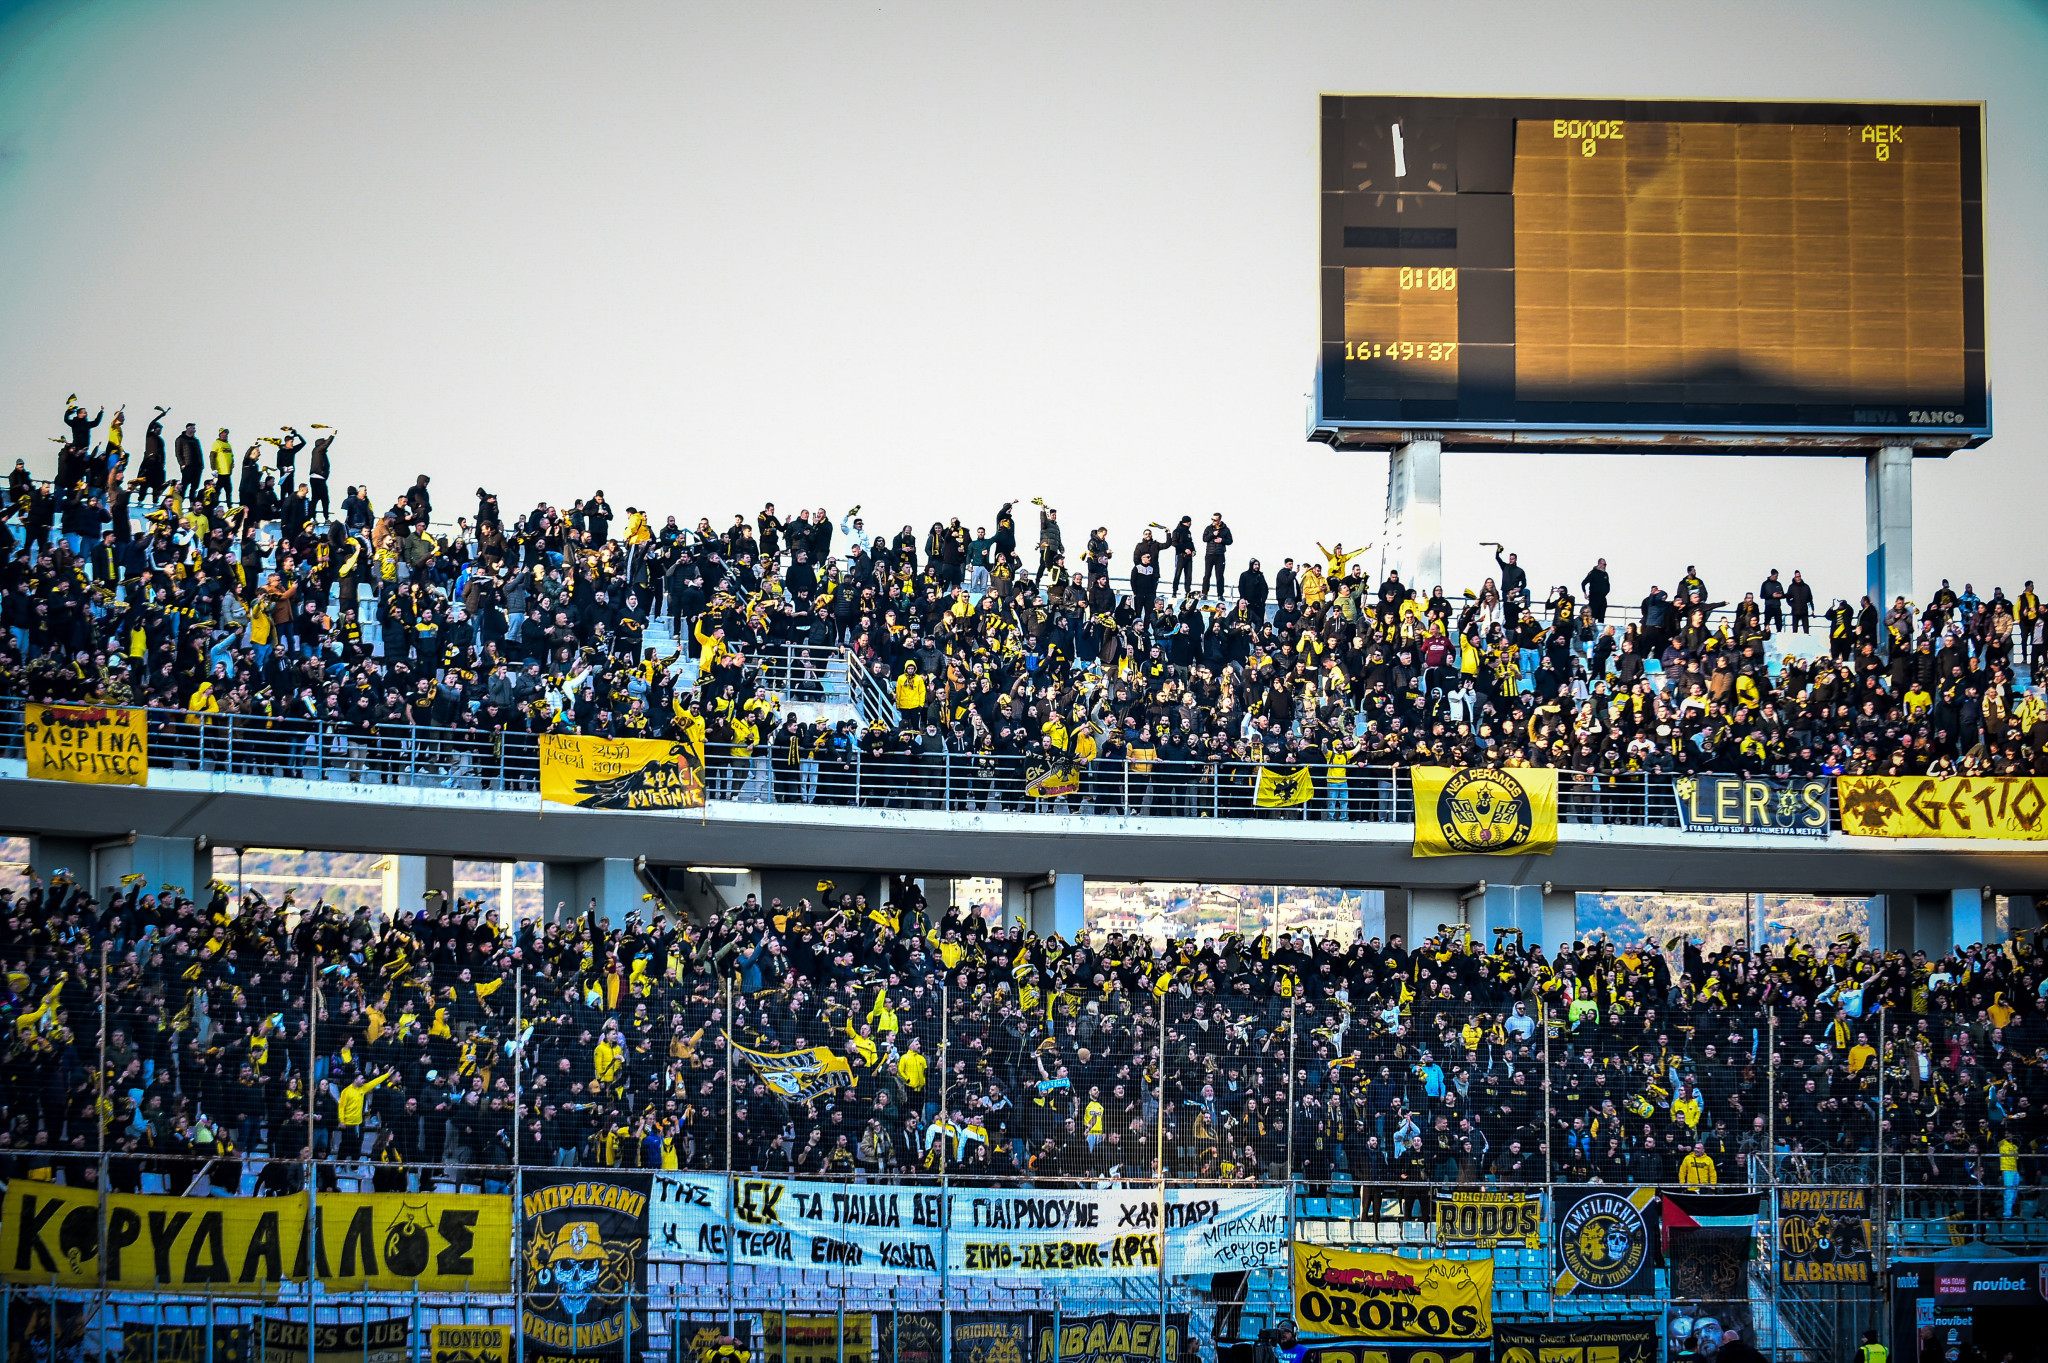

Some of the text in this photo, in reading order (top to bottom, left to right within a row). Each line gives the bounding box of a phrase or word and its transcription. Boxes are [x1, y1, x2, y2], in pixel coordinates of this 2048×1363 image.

[1553, 119, 1624, 139] ΒΟΛΟΣ
[1861, 125, 1903, 143] ΑΕΚ
[1582, 139, 1596, 157] 0
[1876, 144, 1890, 161] 0
[1400, 267, 1456, 291] 0:00
[1345, 341, 1457, 361] 16:49:37
[1446, 769, 1523, 798] NEA PERAMOS
[628, 788, 704, 808] ΚΑΤΕΡΙΝΗΣ
[523, 1182, 646, 1220] ΜΠΡΑΧΑΜΙ
[655, 1175, 711, 1206] ΤΗΣ
[793, 1193, 823, 1220] ΤΑ
[832, 1193, 900, 1228] ΠΑΙΔΙΑ
[1453, 1192, 1510, 1201] ORIGINAL
[1782, 1190, 1865, 1209] ΑΡΡΩΣΤΕΙΑ
[1440, 1203, 1538, 1237] RODOS
[1566, 1199, 1641, 1233] AMFILOCHIA
[1476, 1239, 1498, 1248] CLUB
[1783, 1217, 1812, 1253] ΑΕΚ
[811, 1236, 863, 1265] ΕΙΝΑΙ
[1565, 1243, 1642, 1284] ALWAYS BY YOUR SIDE
[1783, 1262, 1867, 1281] LABRINI
[1973, 1277, 2026, 1291] novibet
[1300, 1290, 1478, 1336] OROPOS
[1935, 1316, 1973, 1326] novibet
[254, 1321, 405, 1347] SERRES CLUB
[438, 1329, 501, 1349] ΠΟΝΤΟΣ
[955, 1324, 1024, 1342] ORIGINAL 21
